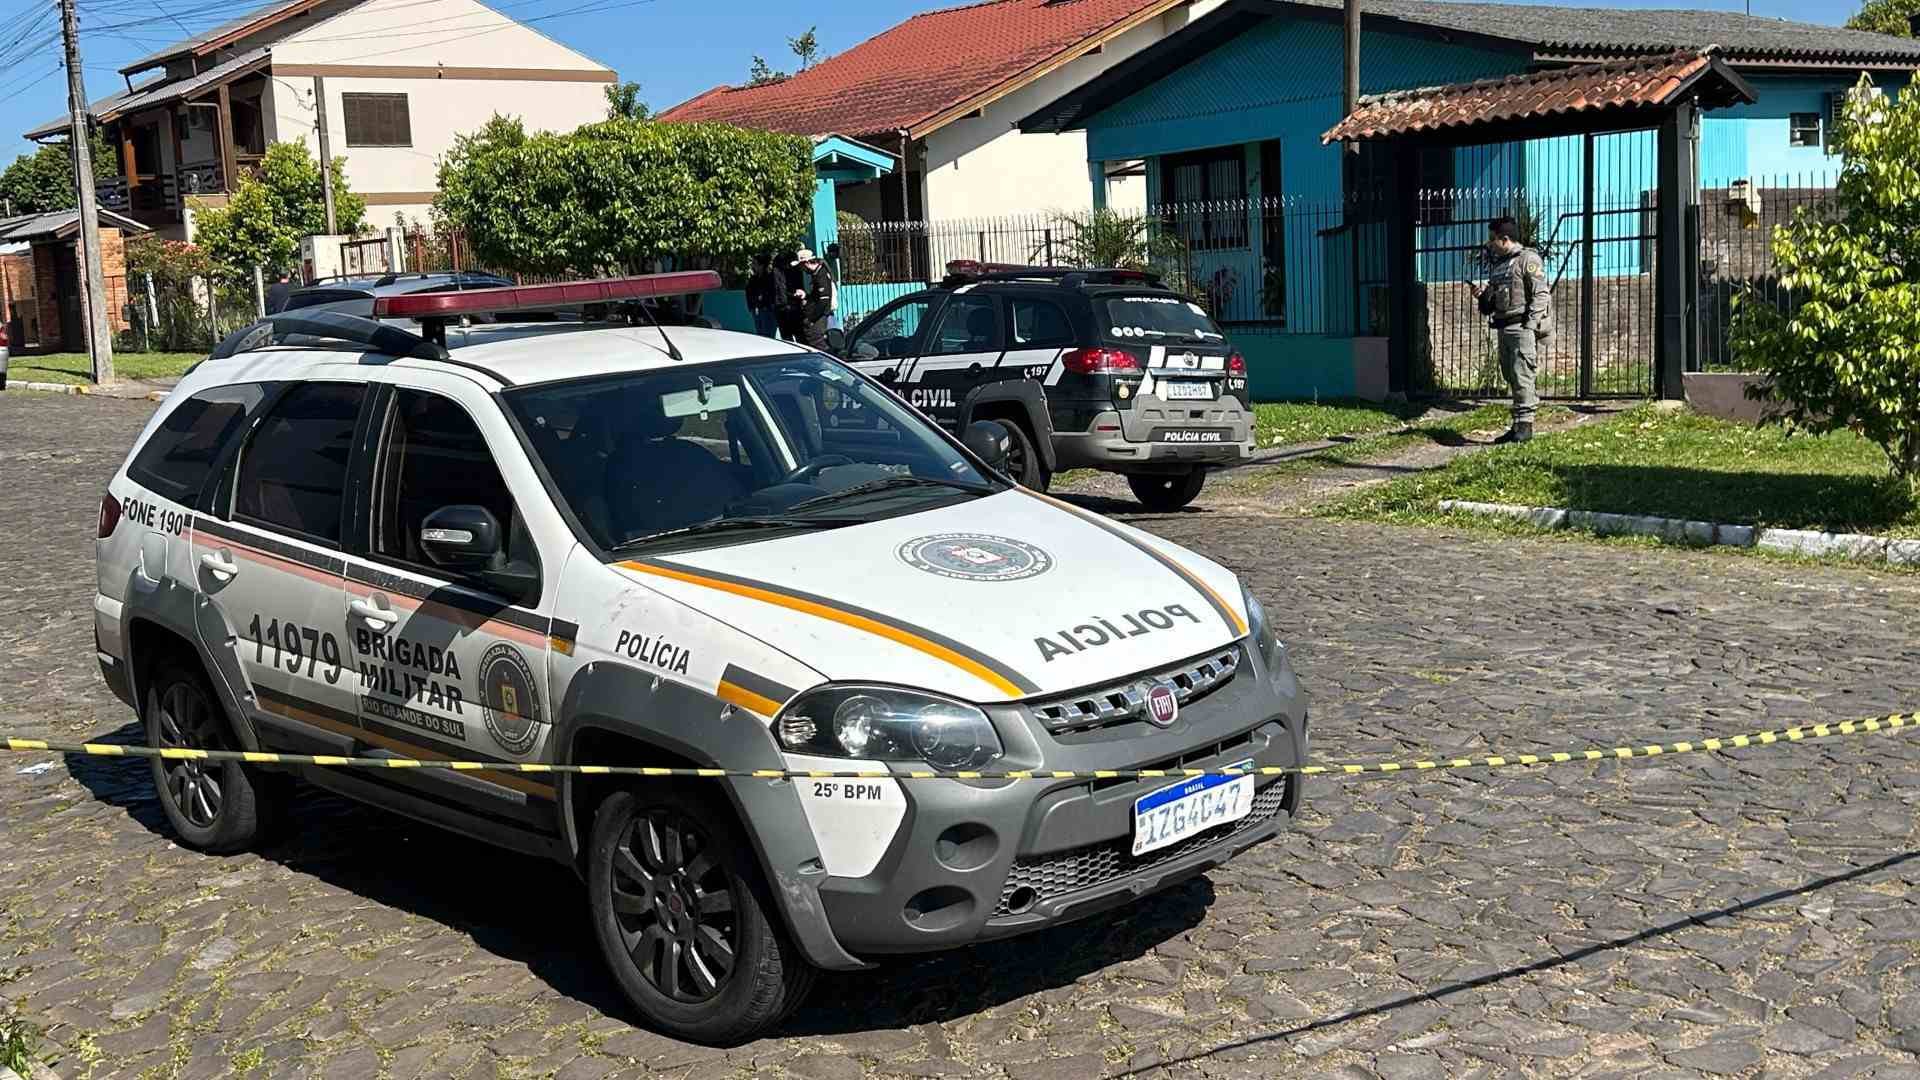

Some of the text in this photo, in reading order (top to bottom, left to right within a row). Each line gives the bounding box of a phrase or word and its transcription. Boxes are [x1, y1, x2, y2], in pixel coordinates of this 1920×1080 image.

[1030, 366, 1048, 377] 197
[1233, 380, 1245, 389] 197
[911, 388, 956, 408] CIVIL
[1164, 430, 1221, 441] POLÍCIA CIVIL
[121, 497, 183, 536] FONE 190
[250, 614, 341, 684] 11979
[356, 628, 461, 680] BRIGADA
[615, 629, 690, 675] POLÍCIA
[359, 662, 463, 714] MILITAR
[361, 698, 465, 737] RIO GRANDE DO SUL
[1152, 694, 1174, 716] FIAT
[844, 784, 881, 800] BPM
